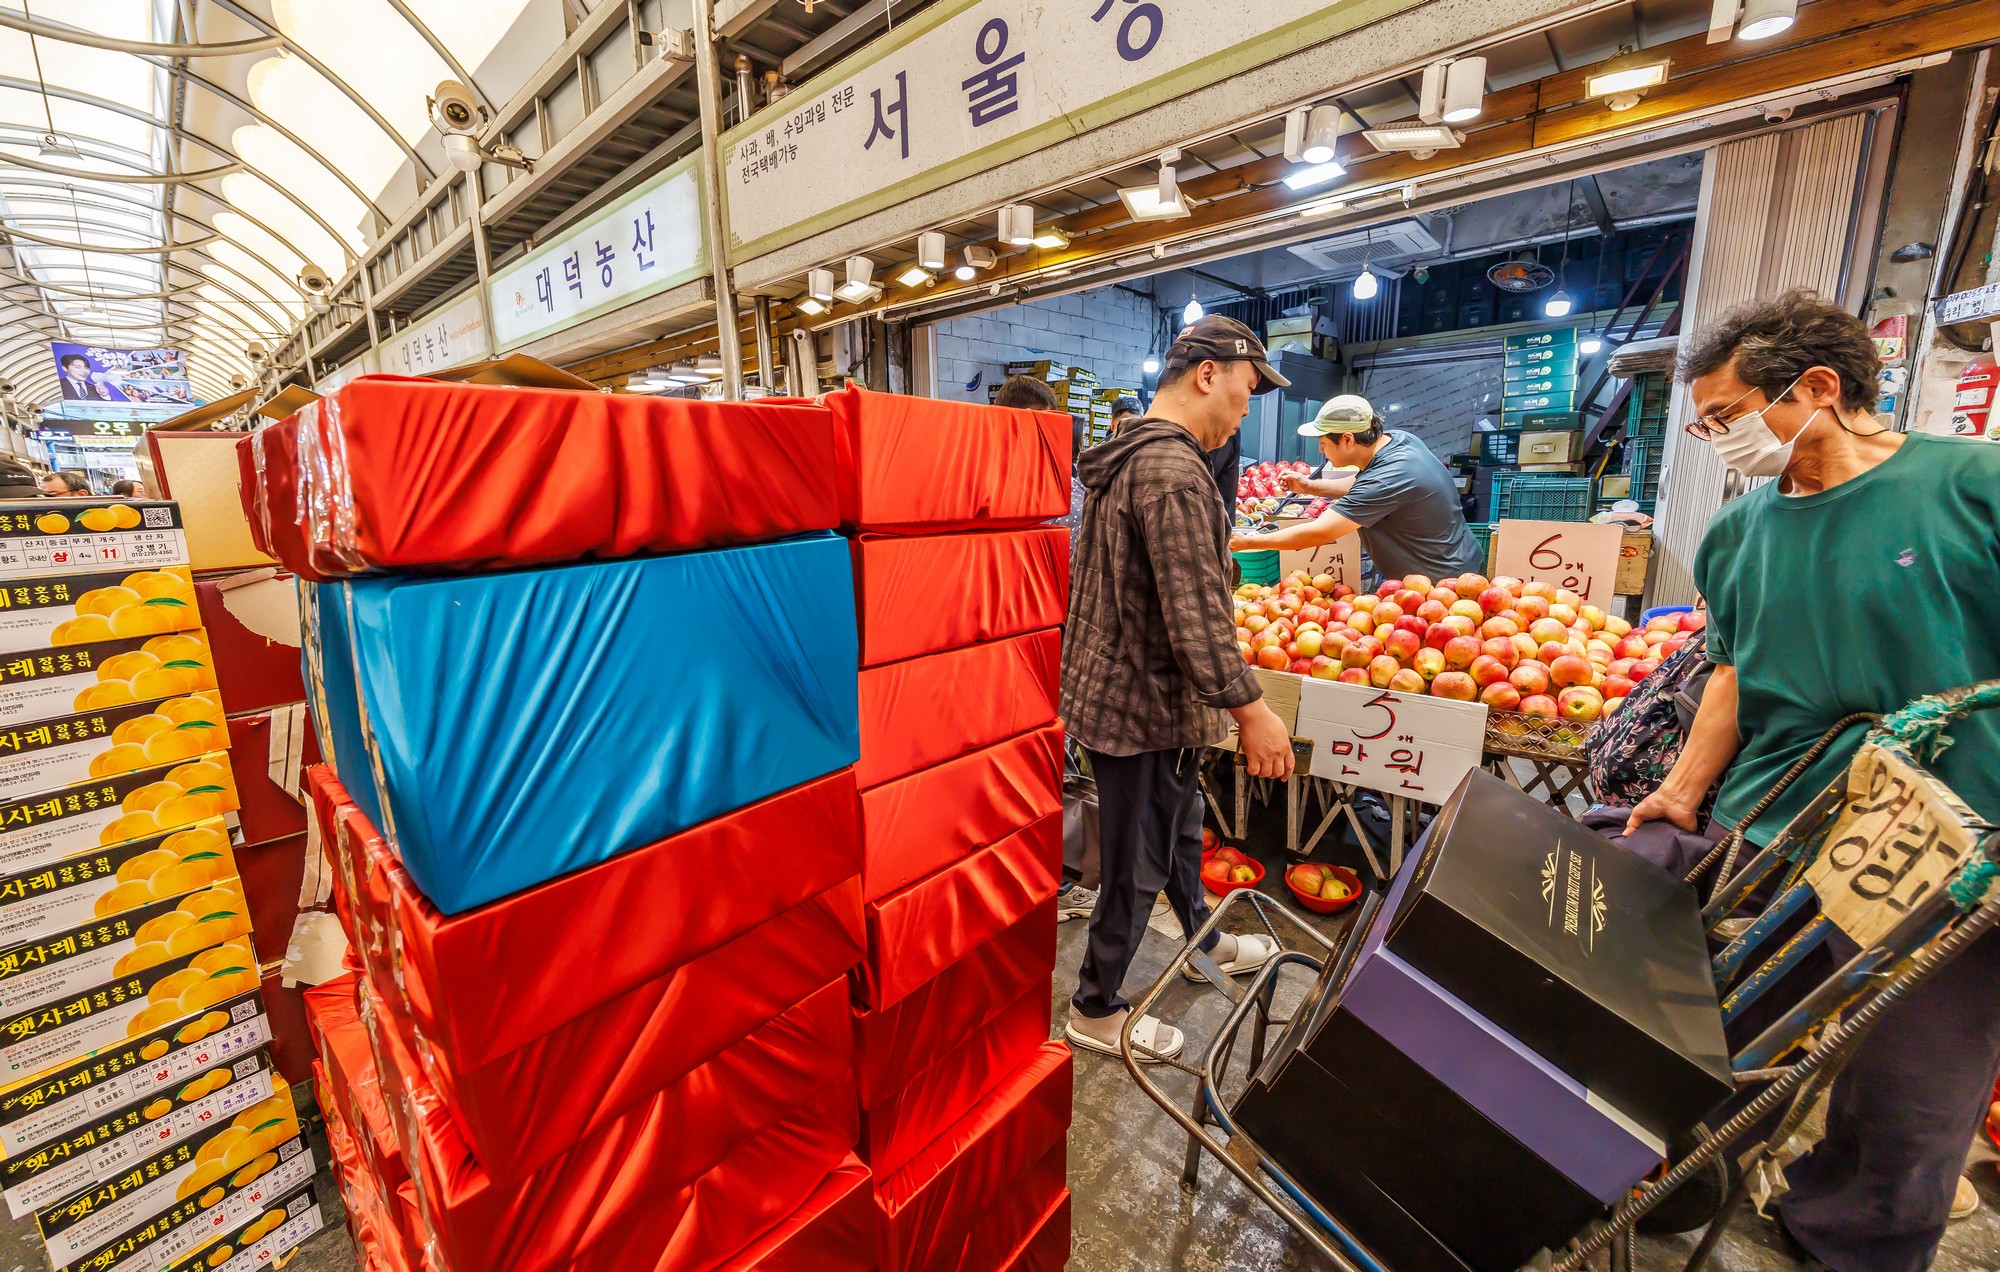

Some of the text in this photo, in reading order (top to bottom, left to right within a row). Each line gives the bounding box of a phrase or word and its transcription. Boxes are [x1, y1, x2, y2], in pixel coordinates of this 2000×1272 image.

[741, 86, 855, 162] 사과, 배, 수입과일 전문
[741, 143, 798, 185] 전국택배가능
[535, 209, 656, 313] 대덕농산
[402, 322, 449, 372] 대덕농산
[1235, 338, 1248, 355] FJ
[94, 422, 131, 436] 오후
[49, 538, 68, 546] 등급
[72, 537, 91, 545] 무게
[134, 533, 164, 541] 생산자
[53, 552, 68, 563] 상
[102, 548, 116, 559] 11
[14, 584, 66, 597] 장호원
[38, 651, 89, 666] 장호원
[55, 717, 104, 733] 장호원
[65, 787, 114, 803] 장호원
[59, 857, 108, 875] 장호원
[1564, 851, 1582, 935] PREMIUM FRUIT GIFT SET
[0, 936, 77, 978] 햇사레
[79, 920, 127, 941] 장호원
[8, 979, 140, 1042] 햇사레 장호원
[195, 1053, 209, 1064] 13
[20, 1052, 134, 1111] 햇사레 장호원
[132, 1069, 148, 1079] 산지
[198, 1110, 212, 1121] 13
[135, 1127, 151, 1138] 산지
[26, 1111, 137, 1173] 햇사레 장호원
[68, 1170, 144, 1221] 햇사레
[145, 1145, 187, 1173] 장호원
[249, 1192, 262, 1203] 16
[95, 1224, 157, 1271] 햇사레
[158, 1202, 194, 1225] 장호원
[257, 1249, 270, 1261] 13
